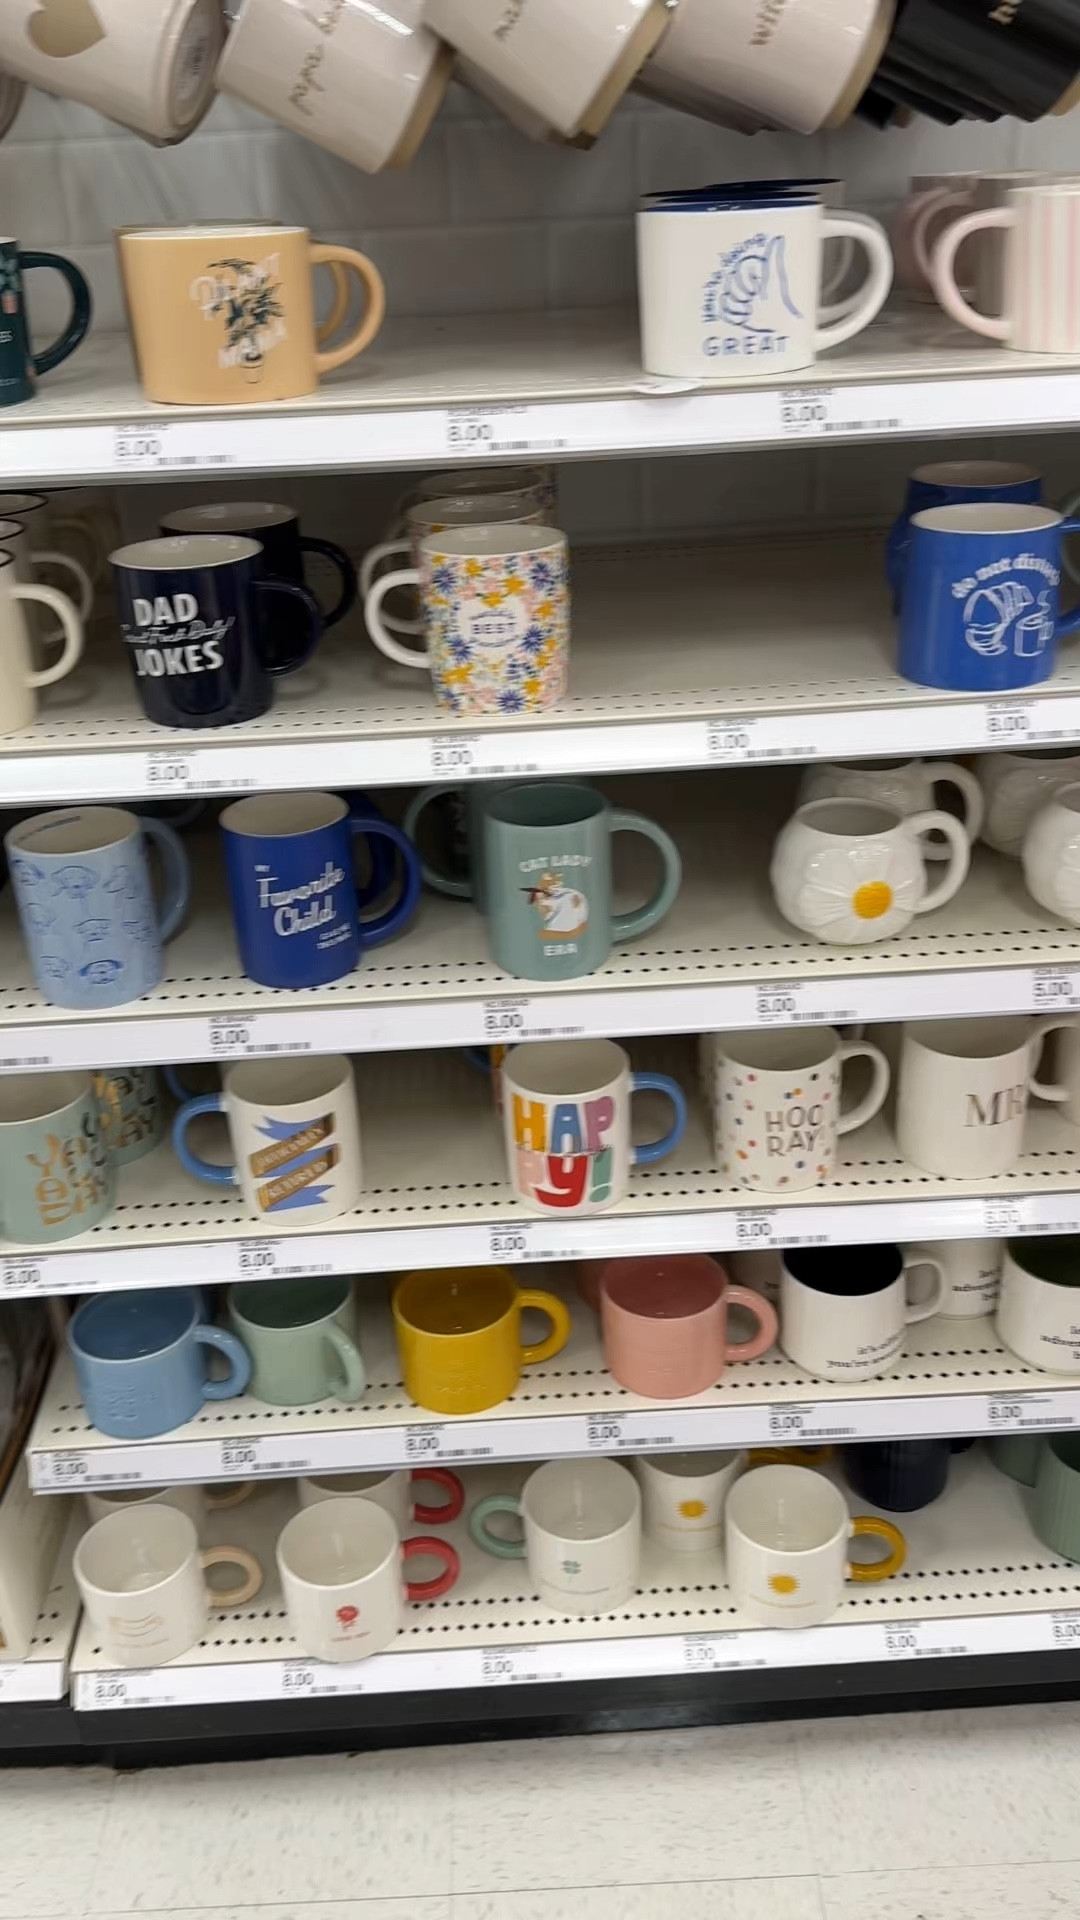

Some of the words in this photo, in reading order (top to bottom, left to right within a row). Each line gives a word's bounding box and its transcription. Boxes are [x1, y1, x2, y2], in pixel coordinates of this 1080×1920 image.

[702, 335, 789, 356] GREAT
[780, 404, 828, 423] 8.00
[446, 424, 492, 442] 8.00
[114, 440, 161, 457] 8.00
[132, 593, 198, 626] DAD
[471, 622, 516, 635] BEST
[134, 640, 224, 677] JOKES
[987, 715, 1030, 732] 8.00
[707, 733, 750, 750] 8.00
[431, 750, 473, 767] 8.00
[146, 765, 190, 781] 8.00
[519, 856, 549, 873] CAT
[550, 854, 593, 868] LADY
[256, 861, 346, 908] Favorite
[274, 894, 337, 937] Child
[543, 943, 578, 956] ERA
[1033, 981, 1073, 997] 5.00
[757, 997, 796, 1013] 8.00
[484, 1013, 523, 1030] 8.00
[209, 1029, 250, 1045] 8.00
[512, 1093, 615, 1154] HAP
[736, 1222, 772, 1238] 8.00
[490, 1236, 527, 1251] 8.00
[239, 1252, 276, 1268] 8.00
[3, 1269, 41, 1285] 8.00
[988, 1405, 1023, 1419] 8.00
[769, 1415, 803, 1430] 8.00
[587, 1425, 622, 1440] 8.00
[405, 1436, 440, 1451] 8.00
[221, 1450, 256, 1465] 8.00
[52, 1462, 88, 1476] 8.00
[885, 1634, 917, 1649] 8.00
[482, 1660, 514, 1675] 8.00
[282, 1672, 314, 1687] 8.00
[95, 1683, 127, 1699] 8.00
